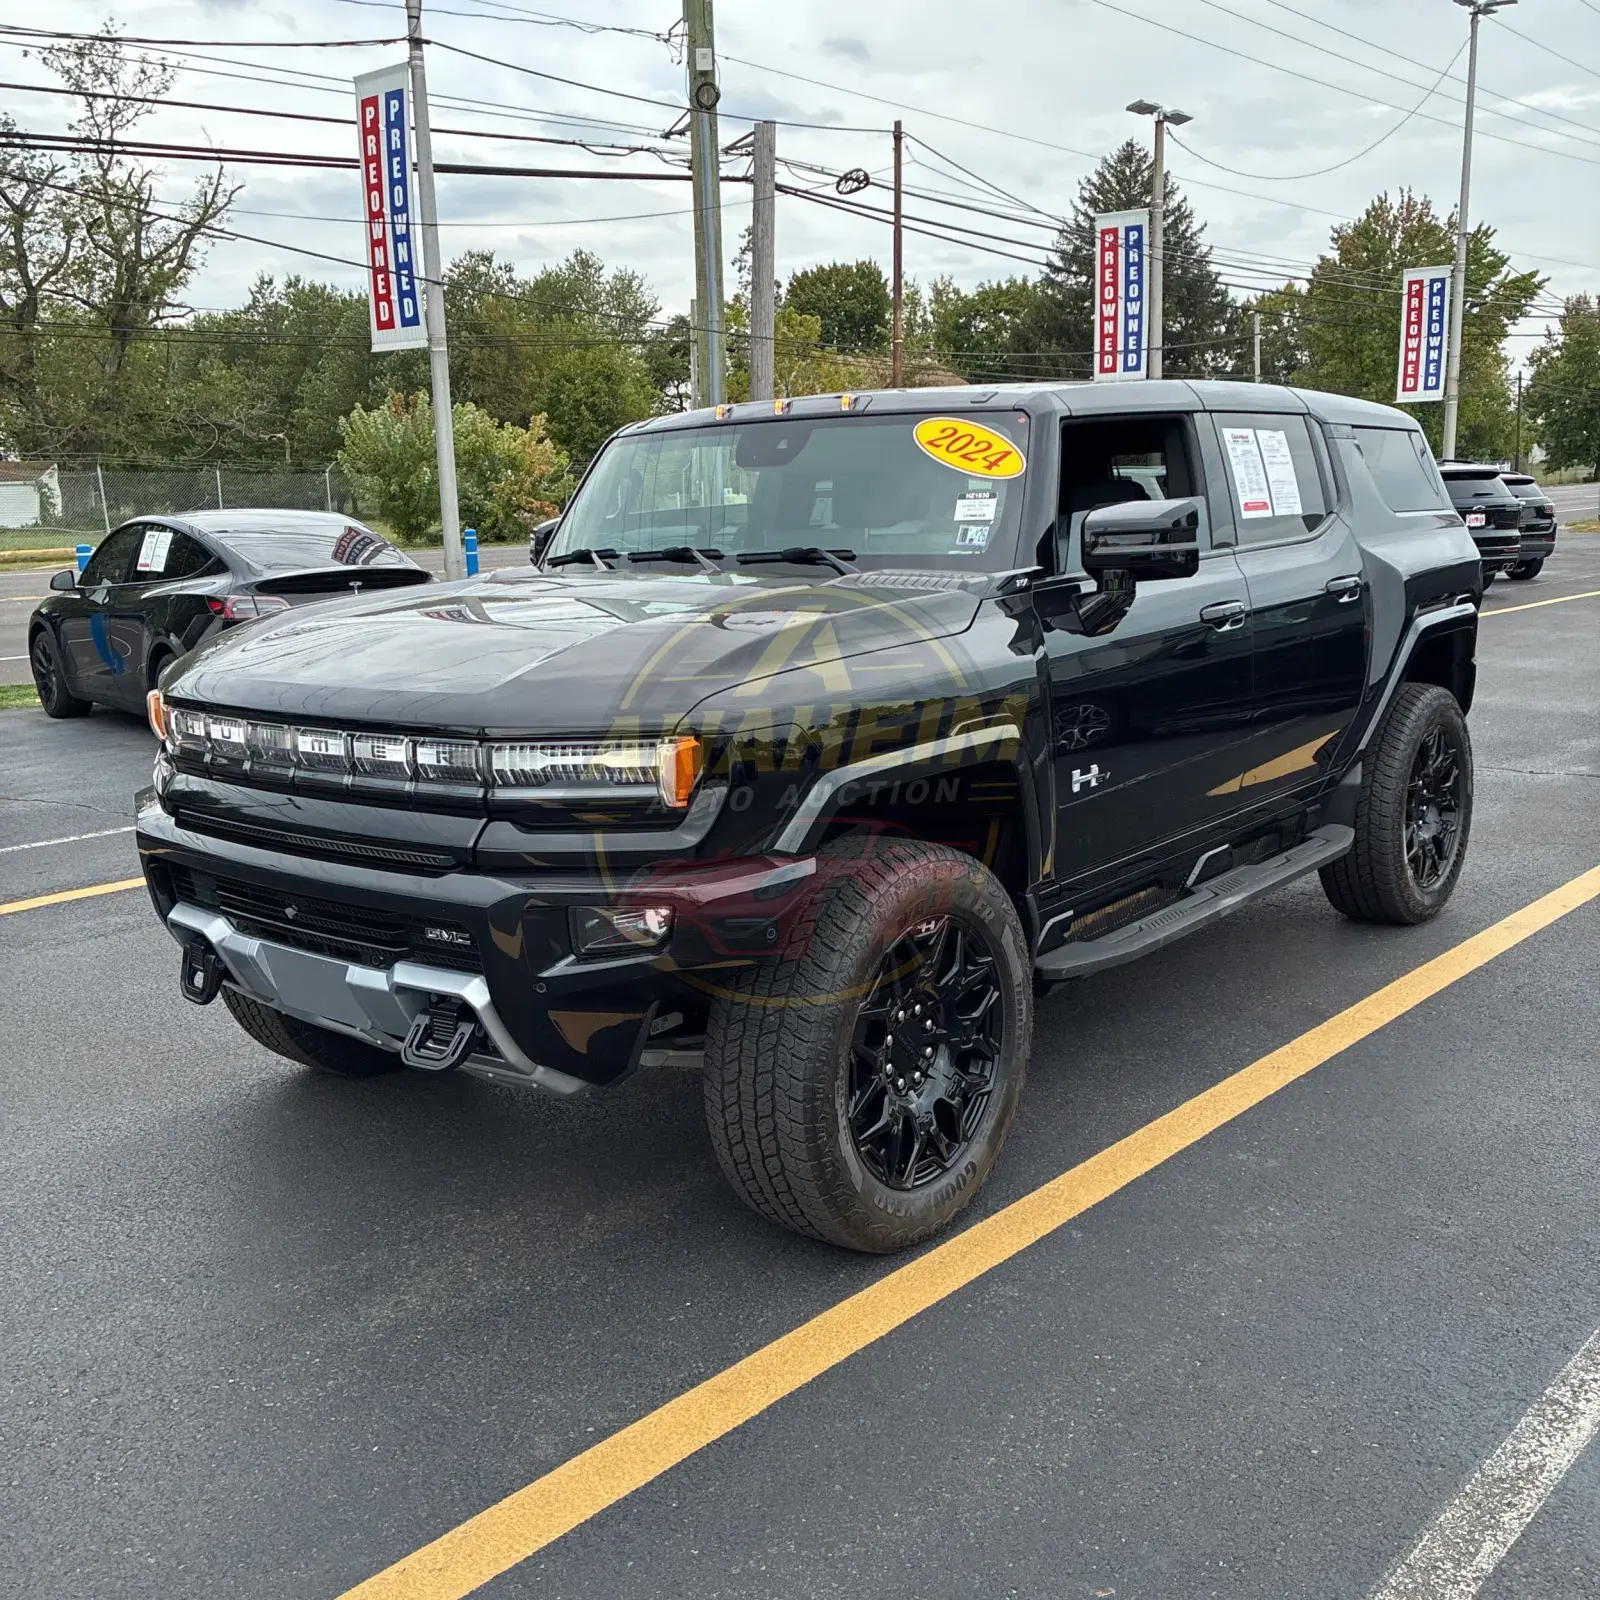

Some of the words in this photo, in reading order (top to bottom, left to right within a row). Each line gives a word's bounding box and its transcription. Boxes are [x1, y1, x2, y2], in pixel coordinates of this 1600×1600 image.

[364, 105, 390, 322] PREOWNED
[389, 98, 413, 319] PREOWNED
[1101, 233, 1117, 369] PREOWNED
[1126, 230, 1141, 367] PREOWNED
[1405, 283, 1420, 388] PREOWNED
[1427, 281, 1442, 387] PREOWNED
[925, 426, 1013, 471] 2024
[186, 719, 455, 766] HUMER
[424, 927, 471, 945] GMC
